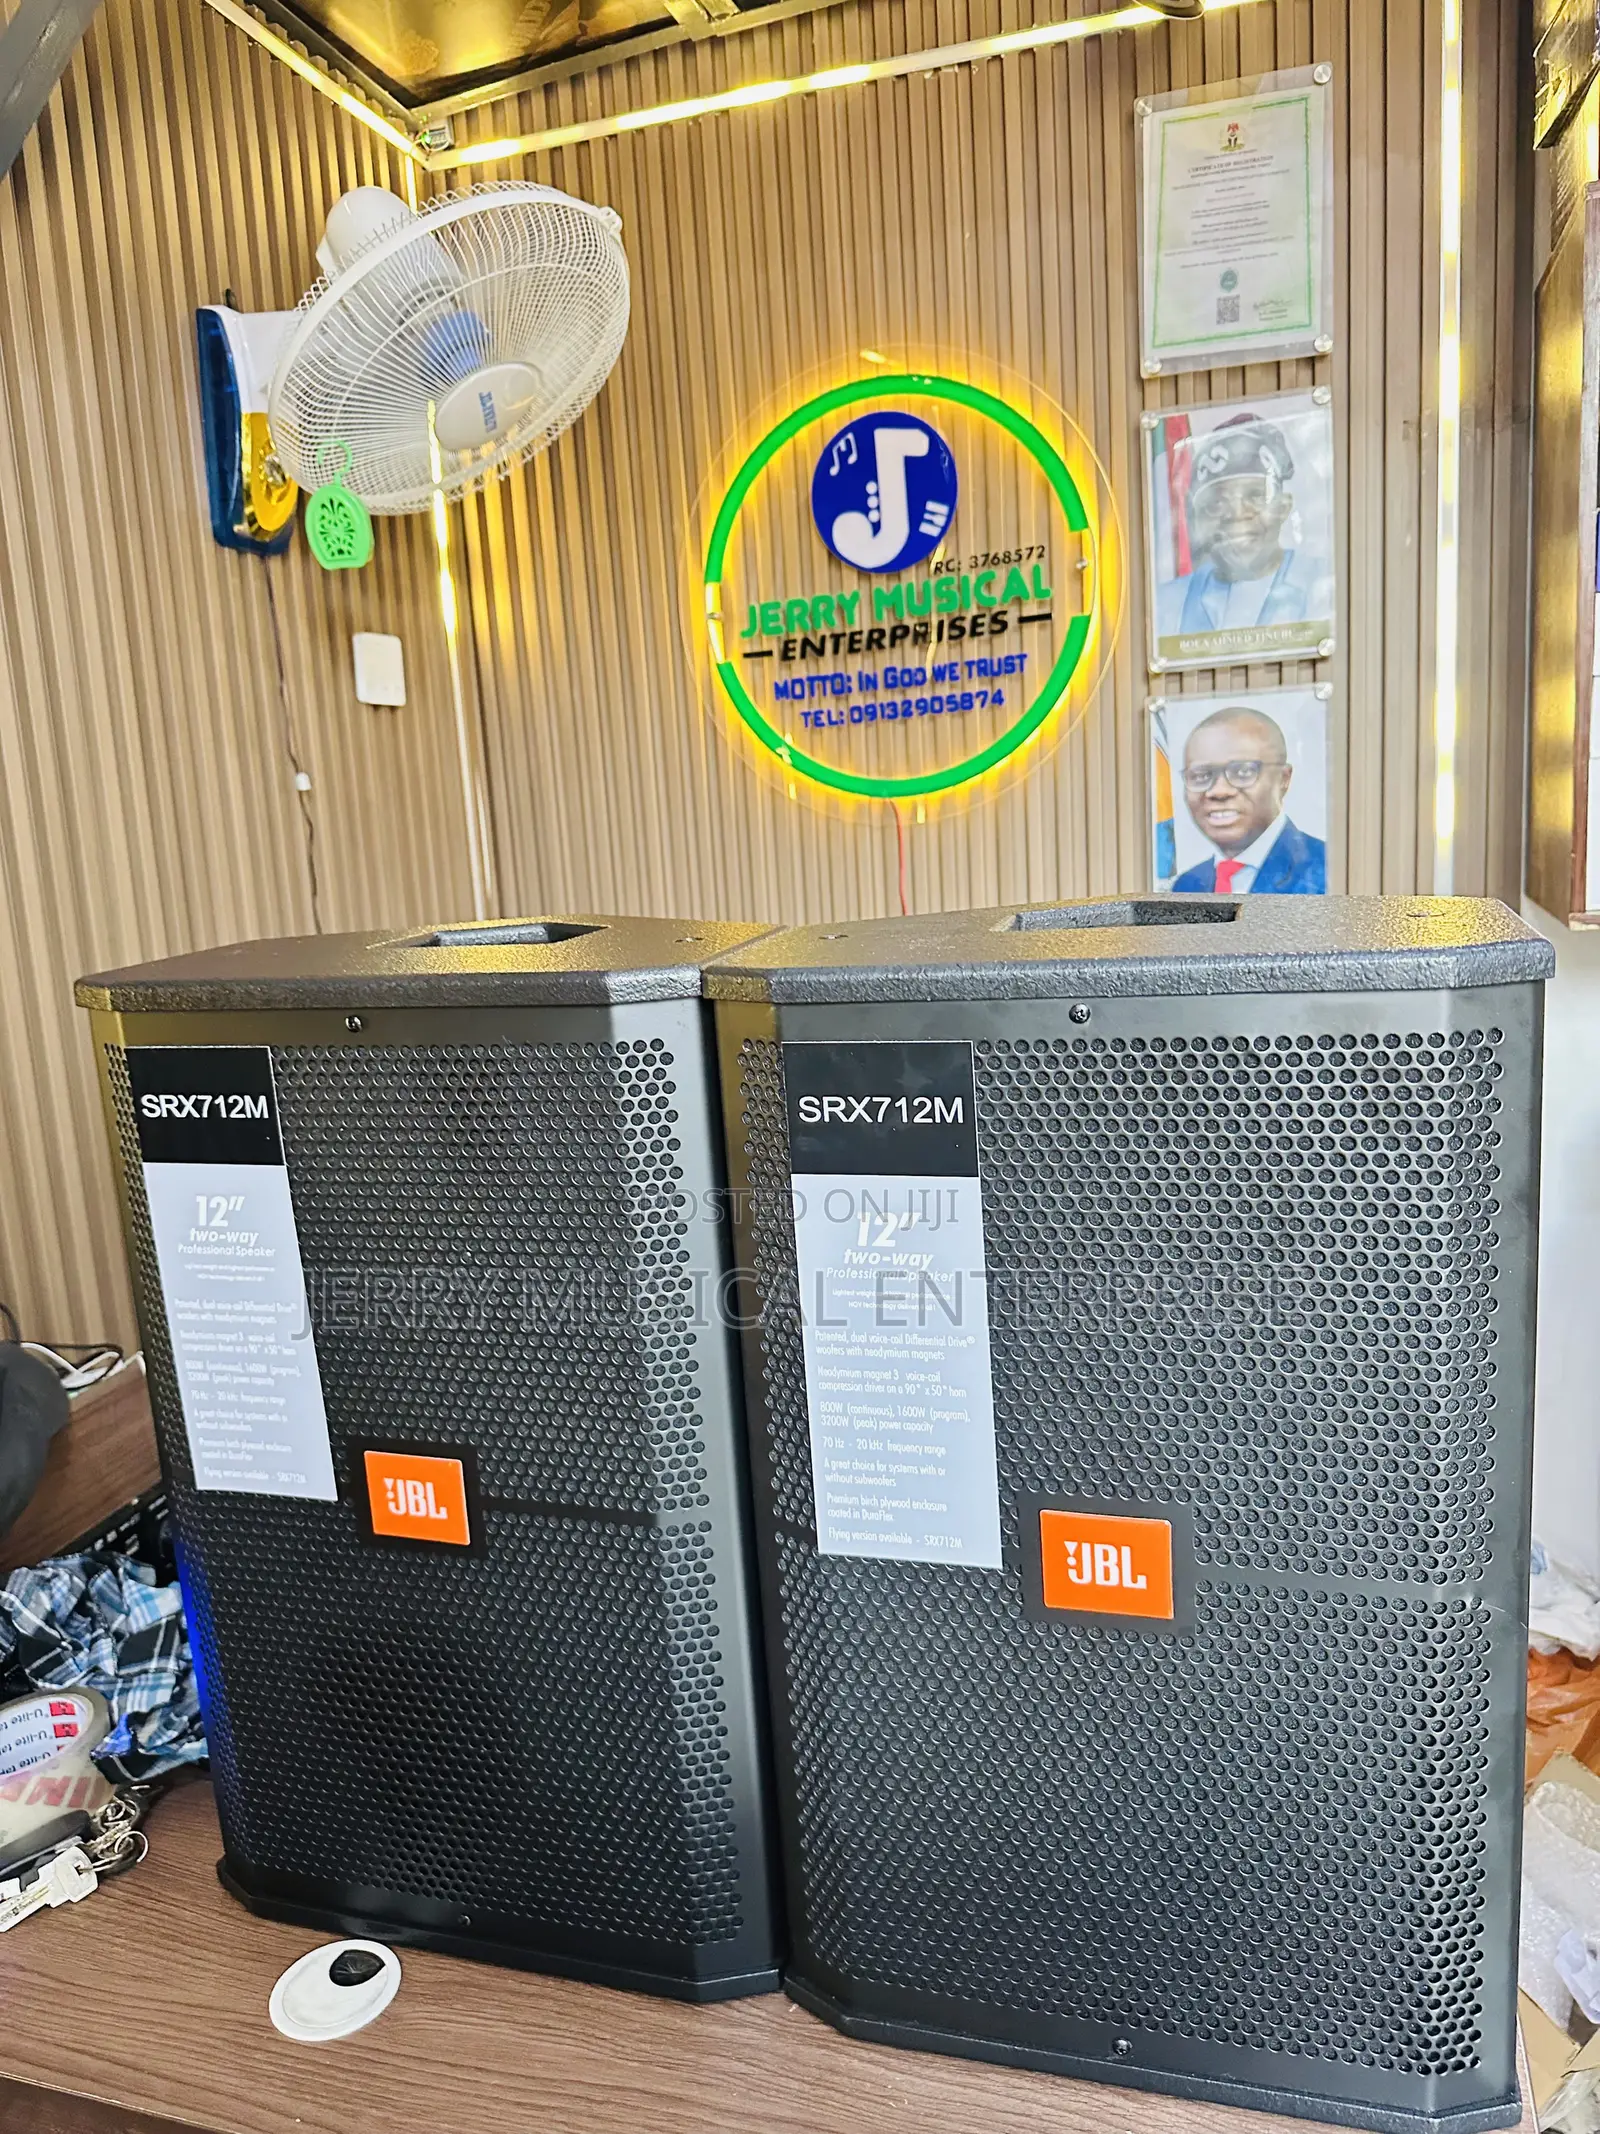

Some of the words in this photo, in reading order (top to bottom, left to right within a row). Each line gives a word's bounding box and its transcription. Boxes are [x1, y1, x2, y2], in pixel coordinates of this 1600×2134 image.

[934, 560, 961, 575] RC:
[970, 545, 1046, 569] 3768572
[740, 590, 861, 639] JERRY
[873, 564, 1053, 622] MUSICAL
[780, 610, 1009, 661] ENTERPRISES
[774, 672, 852, 700] MOTTO:
[964, 653, 1027, 680] TRUST
[801, 709, 845, 728] TEL:
[850, 689, 1005, 724] 09132905874
[141, 1094, 269, 1119] SRX712M
[799, 1096, 964, 1123] SRX712M
[190, 1228, 259, 1247] two-way
[178, 1243, 234, 1256] Professional
[235, 1246, 276, 1257] Speaker
[843, 1249, 934, 1271] two-way
[819, 1401, 844, 1413] 800W
[820, 1414, 850, 1427] 3200W
[822, 1436, 834, 1448] 70
[856, 1438, 868, 1450] 20
[823, 1457, 830, 1468] A
[385, 1477, 448, 1519] JBL
[1065, 1541, 1147, 1590] JBL
[11, 1708, 43, 1725] U-lite
[15, 1730, 48, 1746] U-lite
